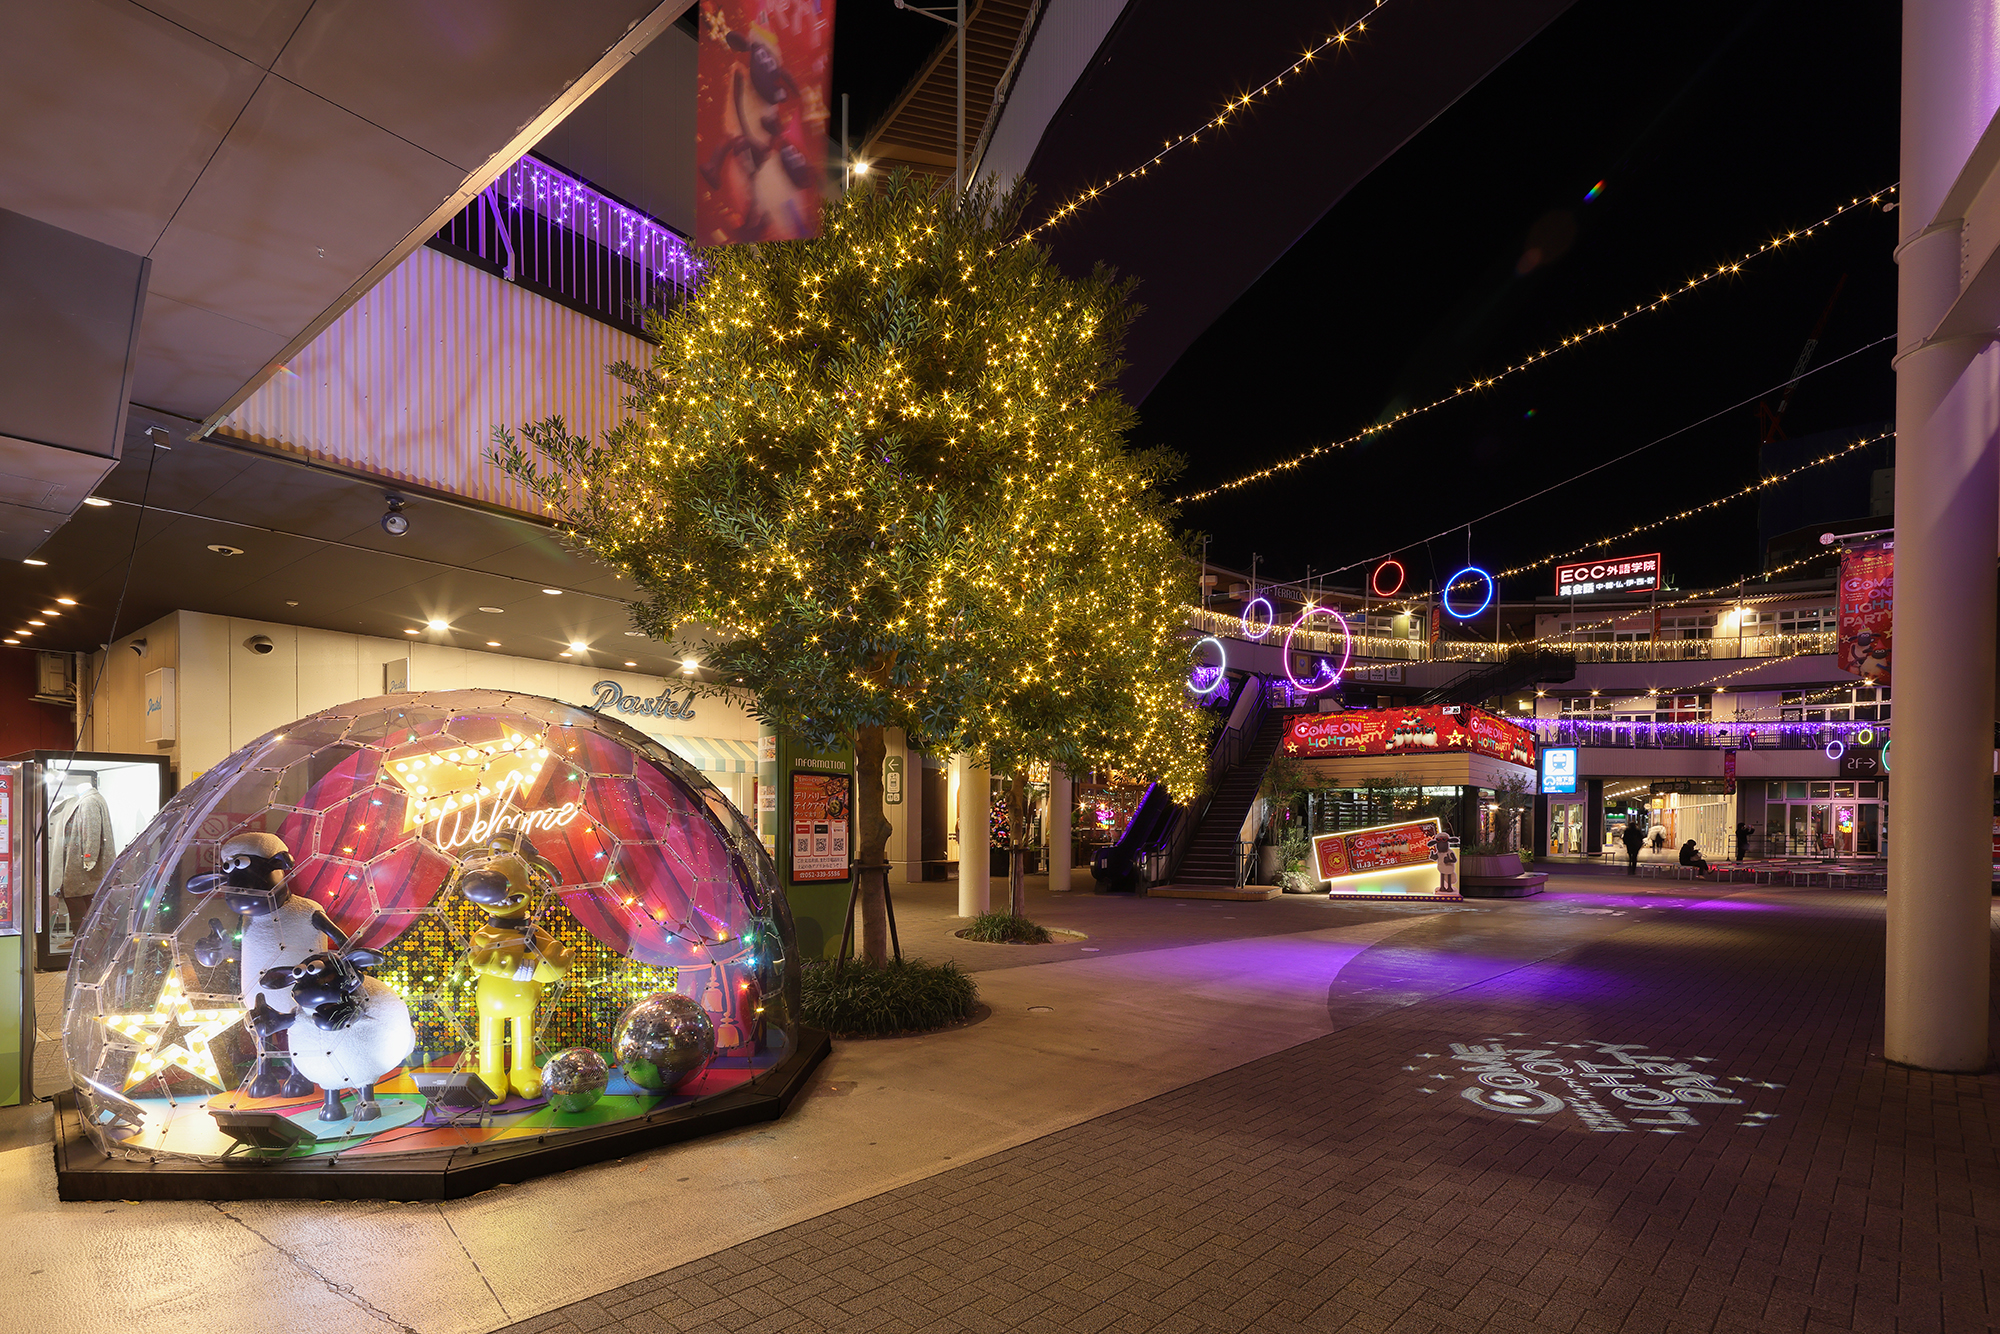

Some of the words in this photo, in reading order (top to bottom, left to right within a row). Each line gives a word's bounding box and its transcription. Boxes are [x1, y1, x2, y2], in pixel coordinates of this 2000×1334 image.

[1844, 577, 1894, 593] COME
[1868, 589, 1894, 599] ON
[592, 680, 696, 720] Pastel
[1294, 722, 1339, 738] COME
[1340, 722, 1362, 734] ON
[1470, 716, 1494, 737] COME
[1493, 728, 1503, 740] ON
[1345, 730, 1386, 747] PARTY
[1847, 757, 1863, 770] 2F
[794, 791, 827, 802] デリバリー
[794, 801, 830, 811] テイクアウト
